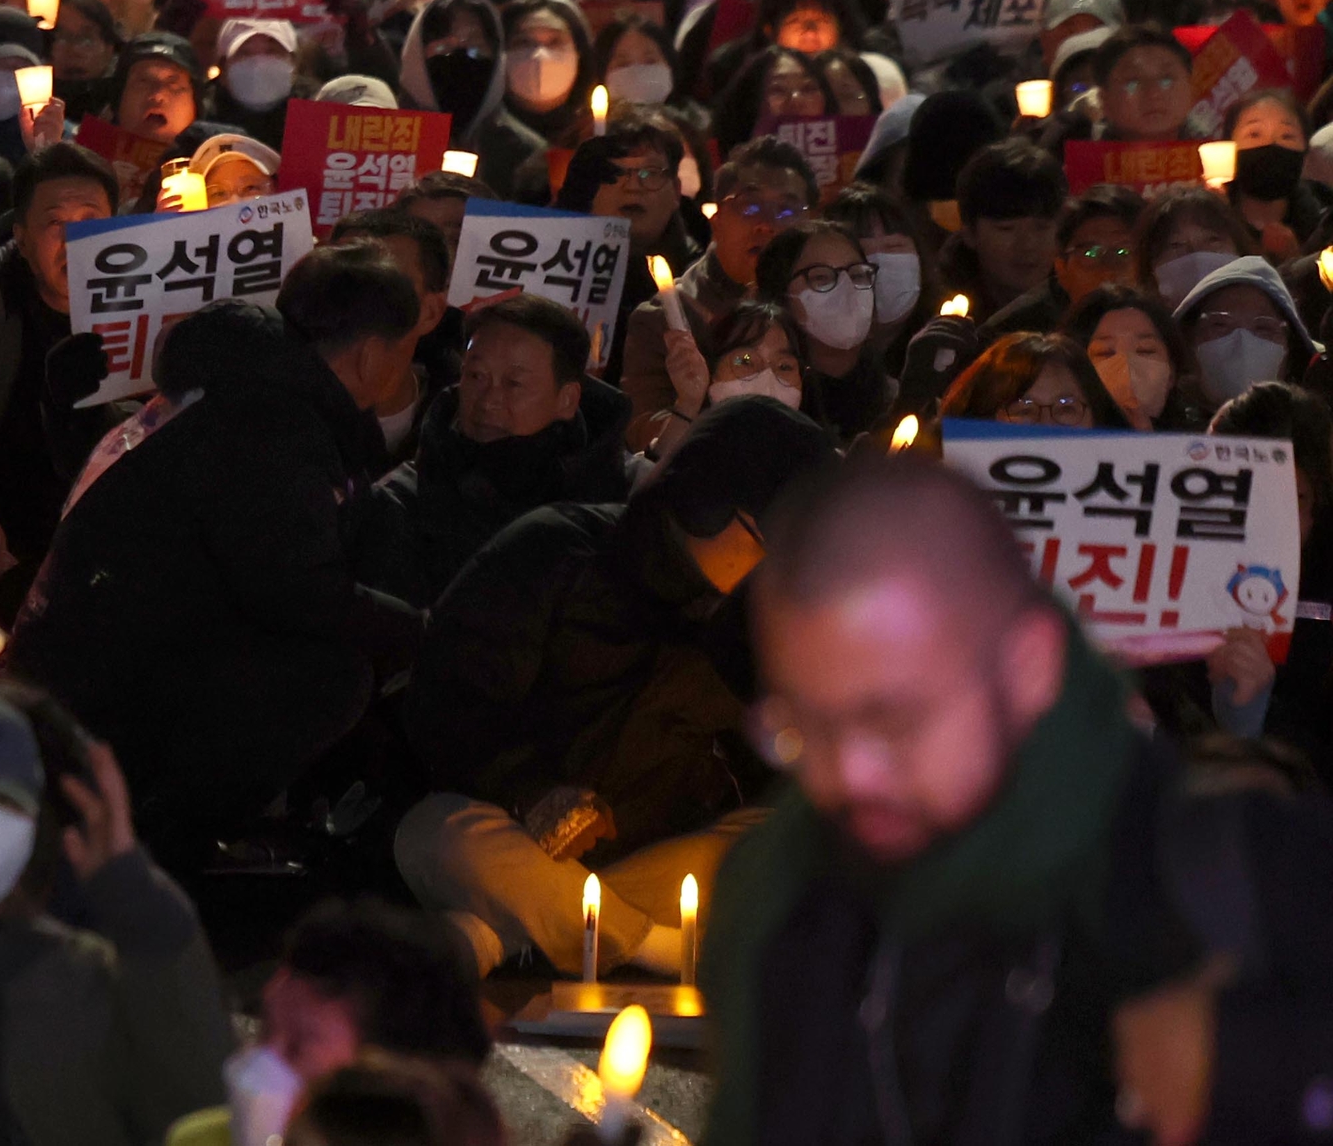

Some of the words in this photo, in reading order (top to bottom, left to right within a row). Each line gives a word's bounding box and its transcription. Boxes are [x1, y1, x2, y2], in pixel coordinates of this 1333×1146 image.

[326, 115, 422, 152] 내란죄
[322, 152, 416, 193] 윤석열
[86, 221, 284, 314] 윤석열
[474, 230, 622, 306] 윤석열
[988, 455, 1254, 542] 윤석열
